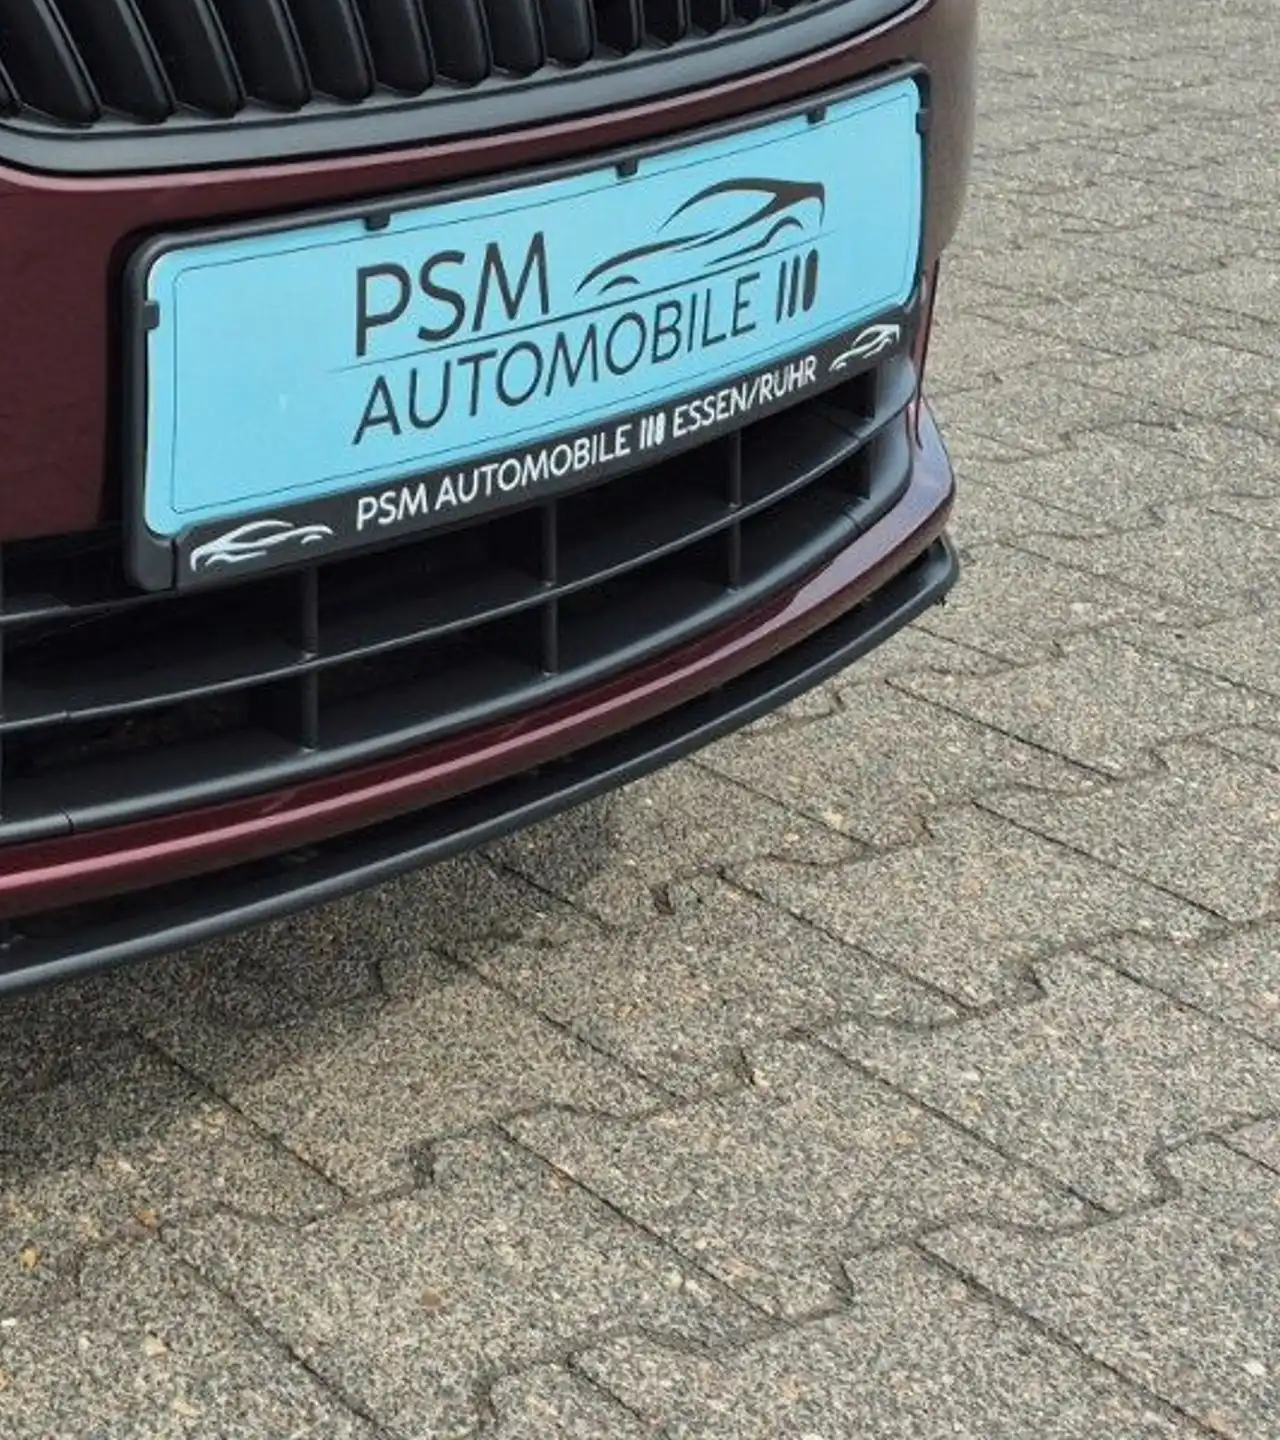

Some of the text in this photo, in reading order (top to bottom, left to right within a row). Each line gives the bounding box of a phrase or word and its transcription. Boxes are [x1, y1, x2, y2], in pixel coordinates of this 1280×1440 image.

[351, 272, 762, 446] AUTOMOBILE
[354, 230, 550, 357] PSM
[355, 354, 818, 532] PSM AUTOMOBILE ESSEN/RUHR
